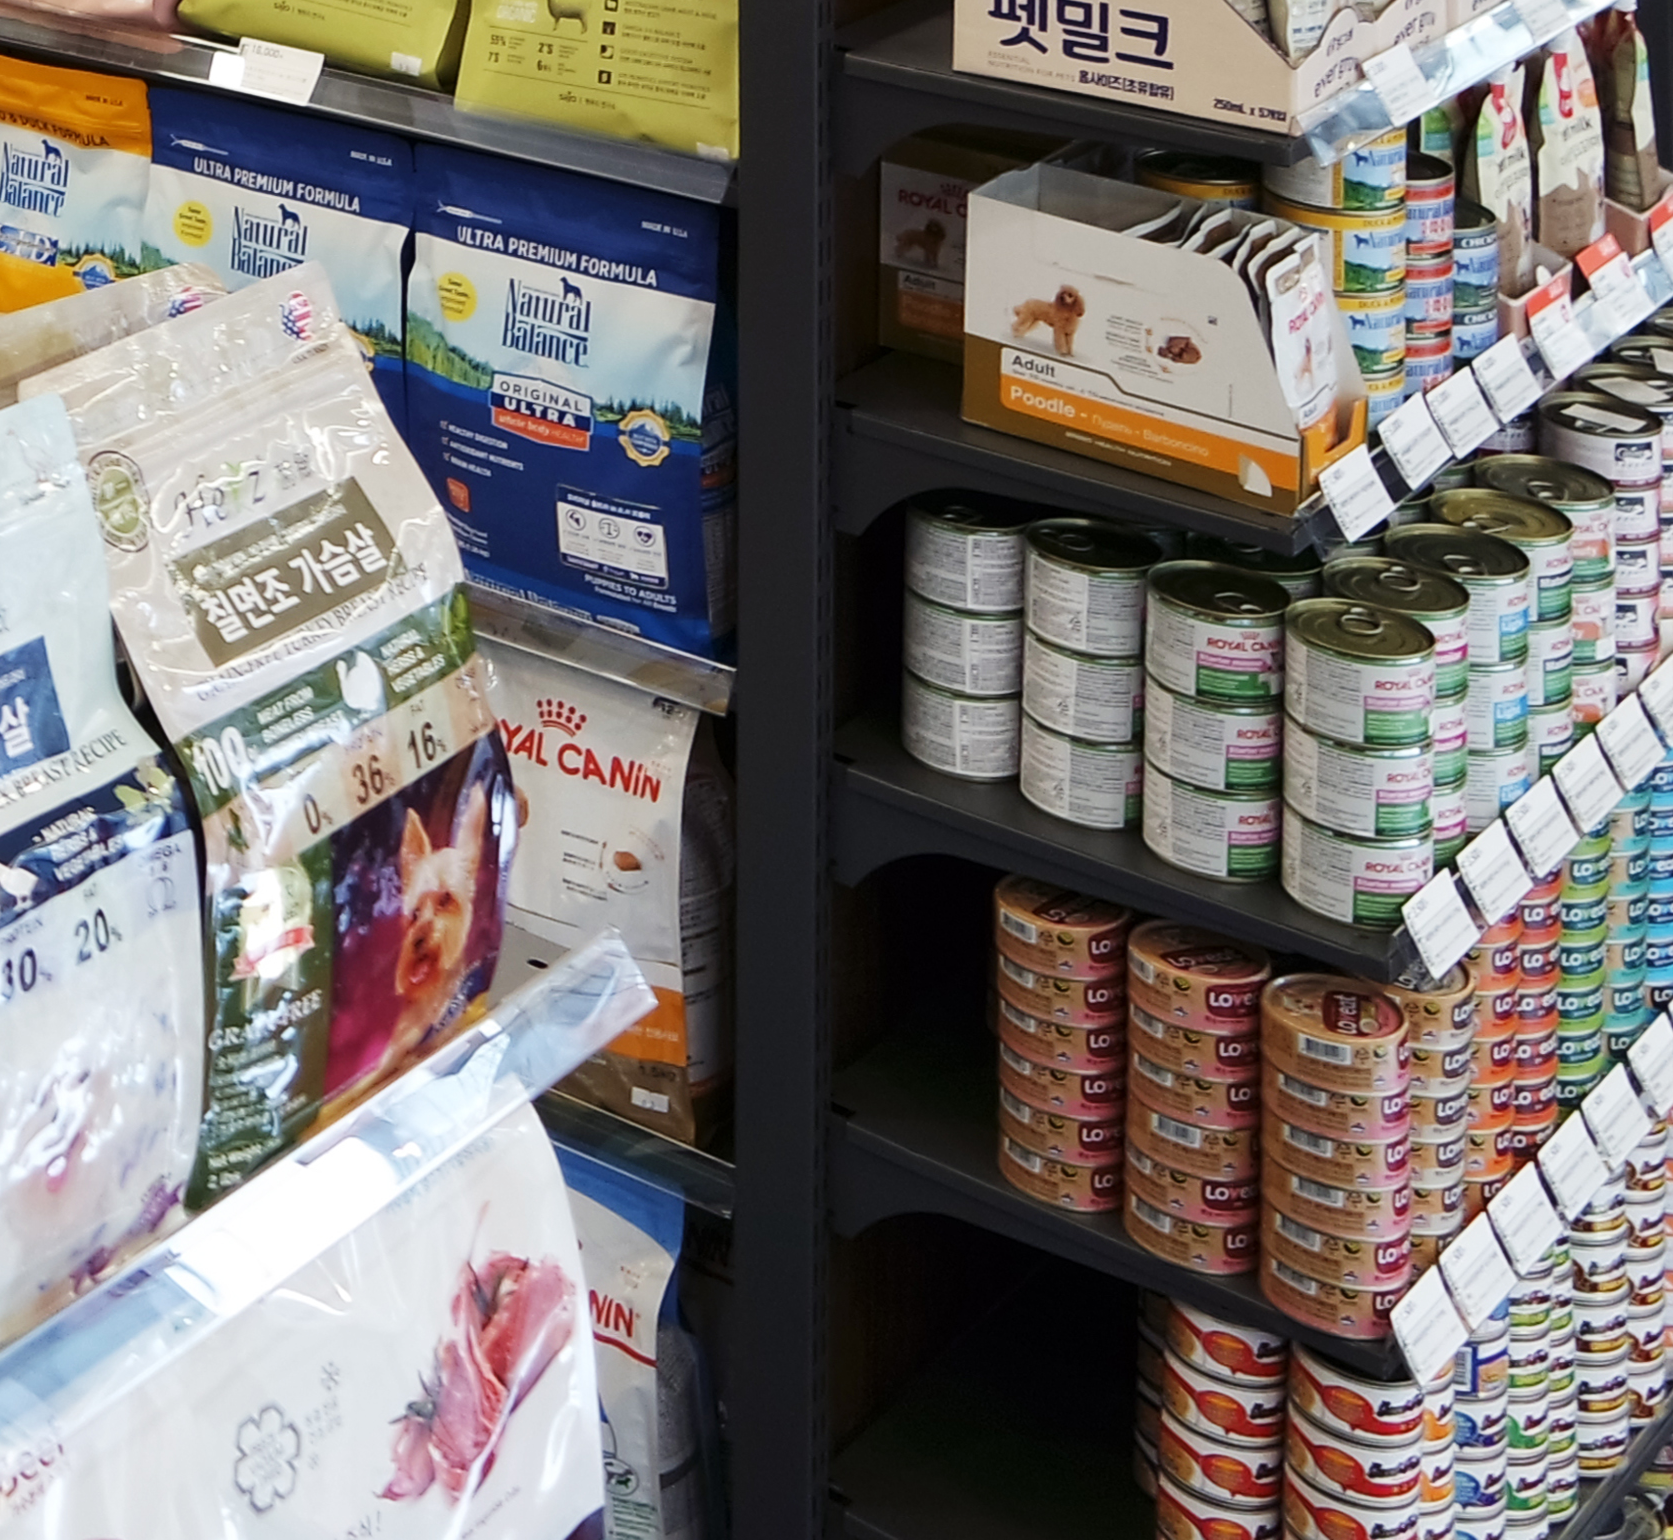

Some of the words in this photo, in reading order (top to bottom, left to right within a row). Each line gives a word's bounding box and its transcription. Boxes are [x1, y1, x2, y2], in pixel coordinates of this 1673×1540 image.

[8, 112, 17, 123] &
[17, 114, 51, 134] DUCK
[52, 124, 110, 148] FORMULA
[1, 142, 70, 187] Natural
[194, 156, 231, 181] ULTRA
[233, 171, 294, 197] PREMIUM
[296, 183, 360, 213] FORMULA
[898, 189, 954, 214] ROYAL
[232, 206, 308, 256] Natural
[457, 225, 504, 252] ULTRA
[508, 237, 577, 269] PREMIUM
[579, 255, 657, 288] FORMULA
[507, 278, 592, 333] Natural
[502, 312, 589, 368] Balance
[1012, 355, 1056, 378] Adult
[500, 379, 583, 413] ORIGINAL
[503, 396, 576, 428] ULTRA
[1010, 385, 1075, 418] Poodle
[1143, 429, 1209, 457] Barboncino
[527, 420, 550, 437] body
[199, 567, 301, 645] 칠면조
[287, 522, 389, 595] 가슴살
[584, 573, 623, 592] PUPPIES
[623, 585, 636, 597] TO
[638, 588, 677, 605] ADULTS
[1207, 638, 1247, 652] ROYAL
[71, 727, 129, 773] RECIPE
[407, 721, 448, 771] 16%
[352, 753, 396, 806] 36%
[561, 743, 662, 804] CANIN
[74, 906, 123, 966] 20%
